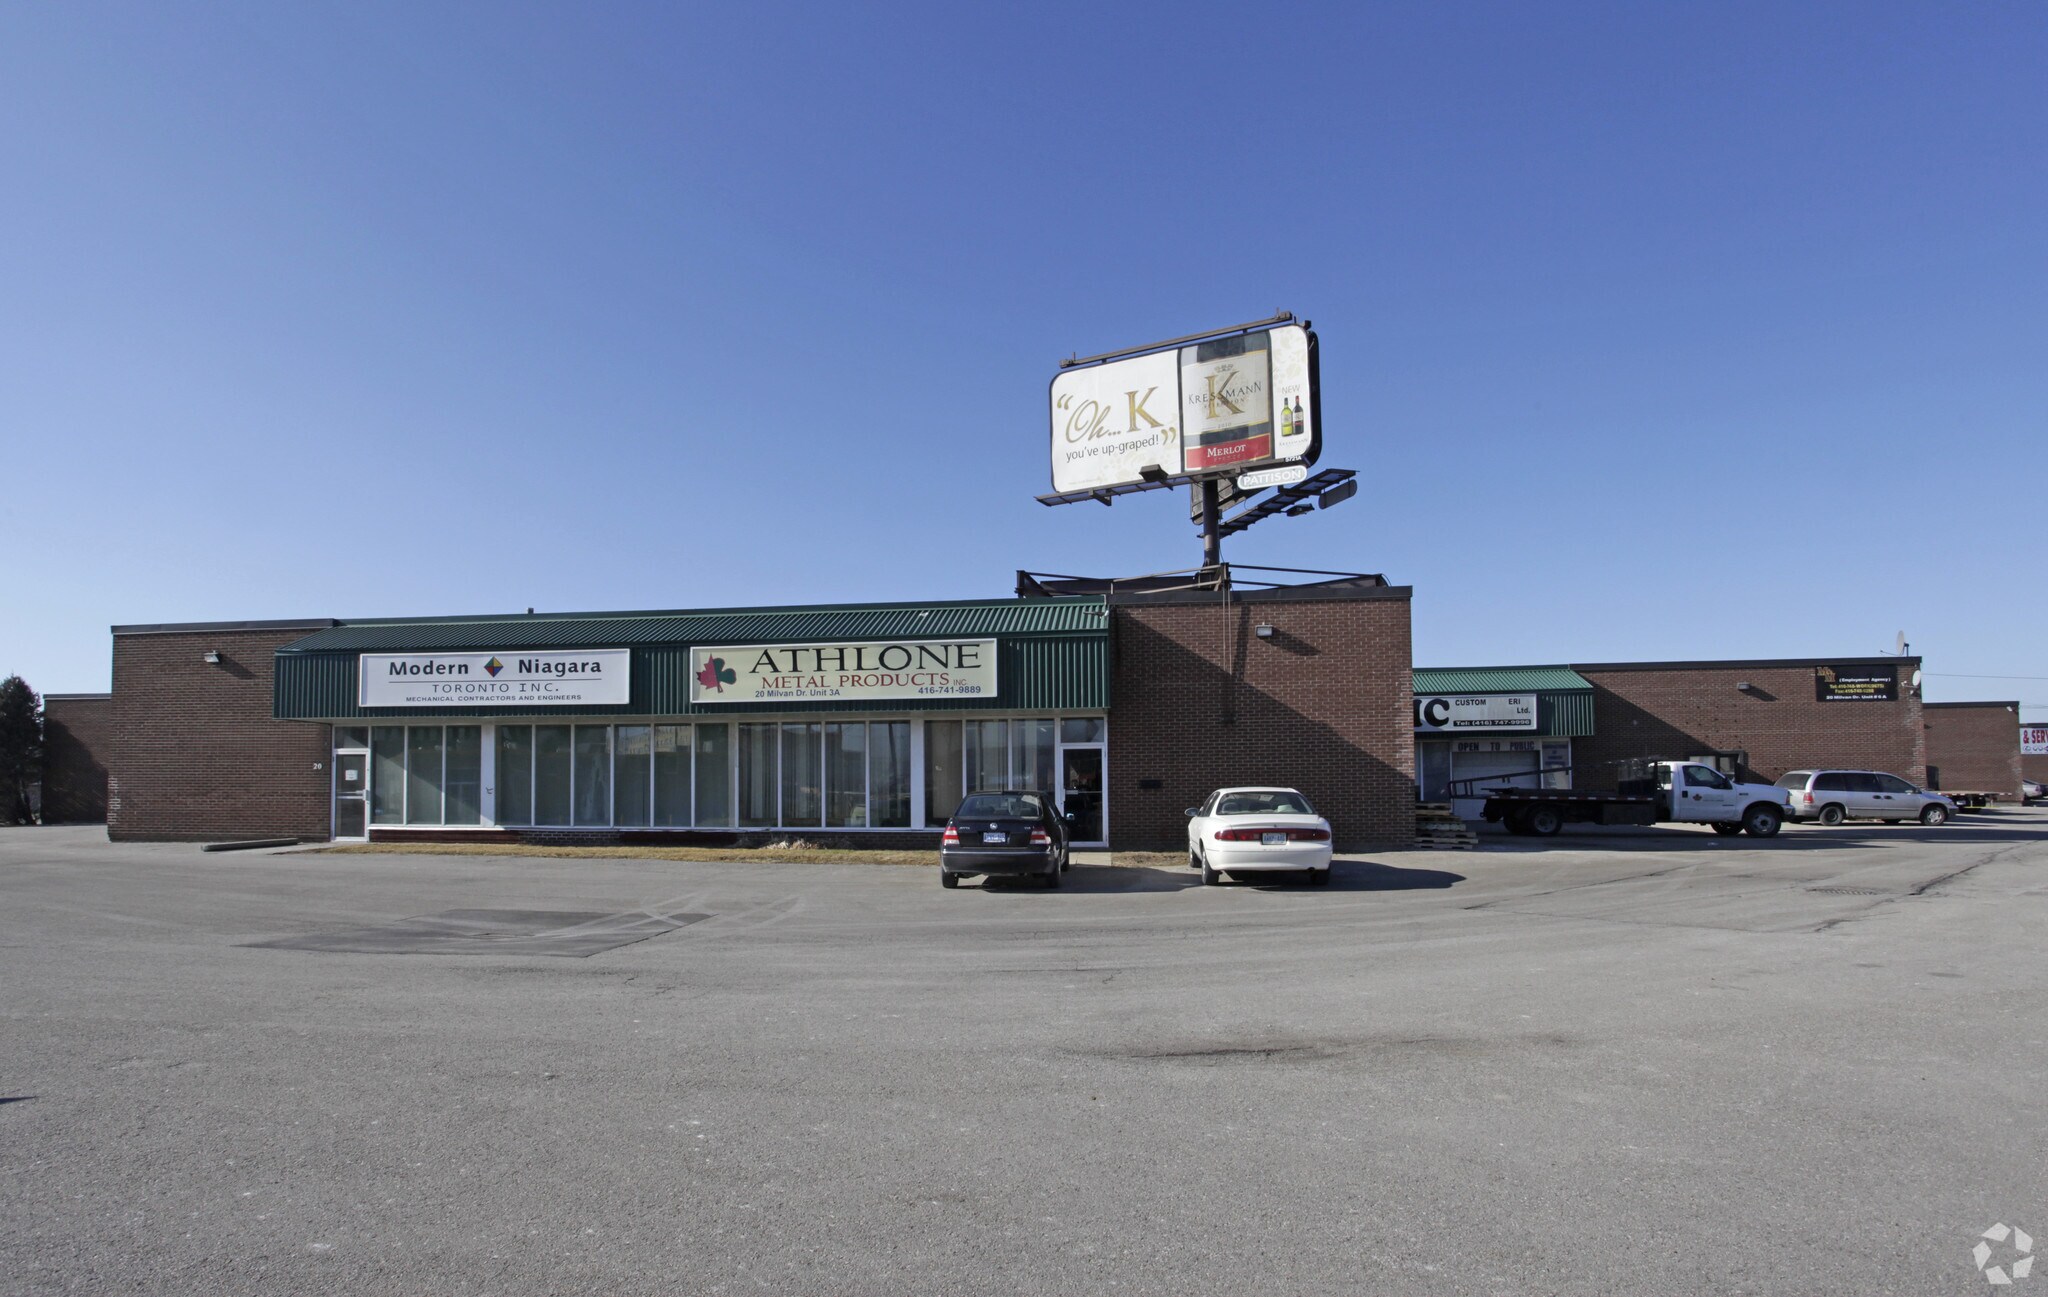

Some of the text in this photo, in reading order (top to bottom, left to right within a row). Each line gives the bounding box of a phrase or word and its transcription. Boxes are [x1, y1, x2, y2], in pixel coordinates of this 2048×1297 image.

[1281, 384, 1301, 394] NEW
[1124, 386, 1164, 432] K
[1207, 444, 1246, 457] MERLOT
[1243, 469, 1301, 486] PATTISON
[749, 643, 982, 673] ATHLONE
[388, 658, 602, 677] Modern Niagara
[761, 675, 830, 689] METAL
[838, 672, 950, 688] PRODUCTS
[432, 682, 560, 693] TORONTO INC.
[755, 688, 841, 698] 20 Milvan Dr. Unit 3A
[918, 685, 982, 695] 416-741-9889
[2023, 730, 2029, 744] &
[1458, 742, 1480, 752] OPEN
[1490, 742, 1500, 751] TO
[1510, 740, 1535, 751] PUBLIC
